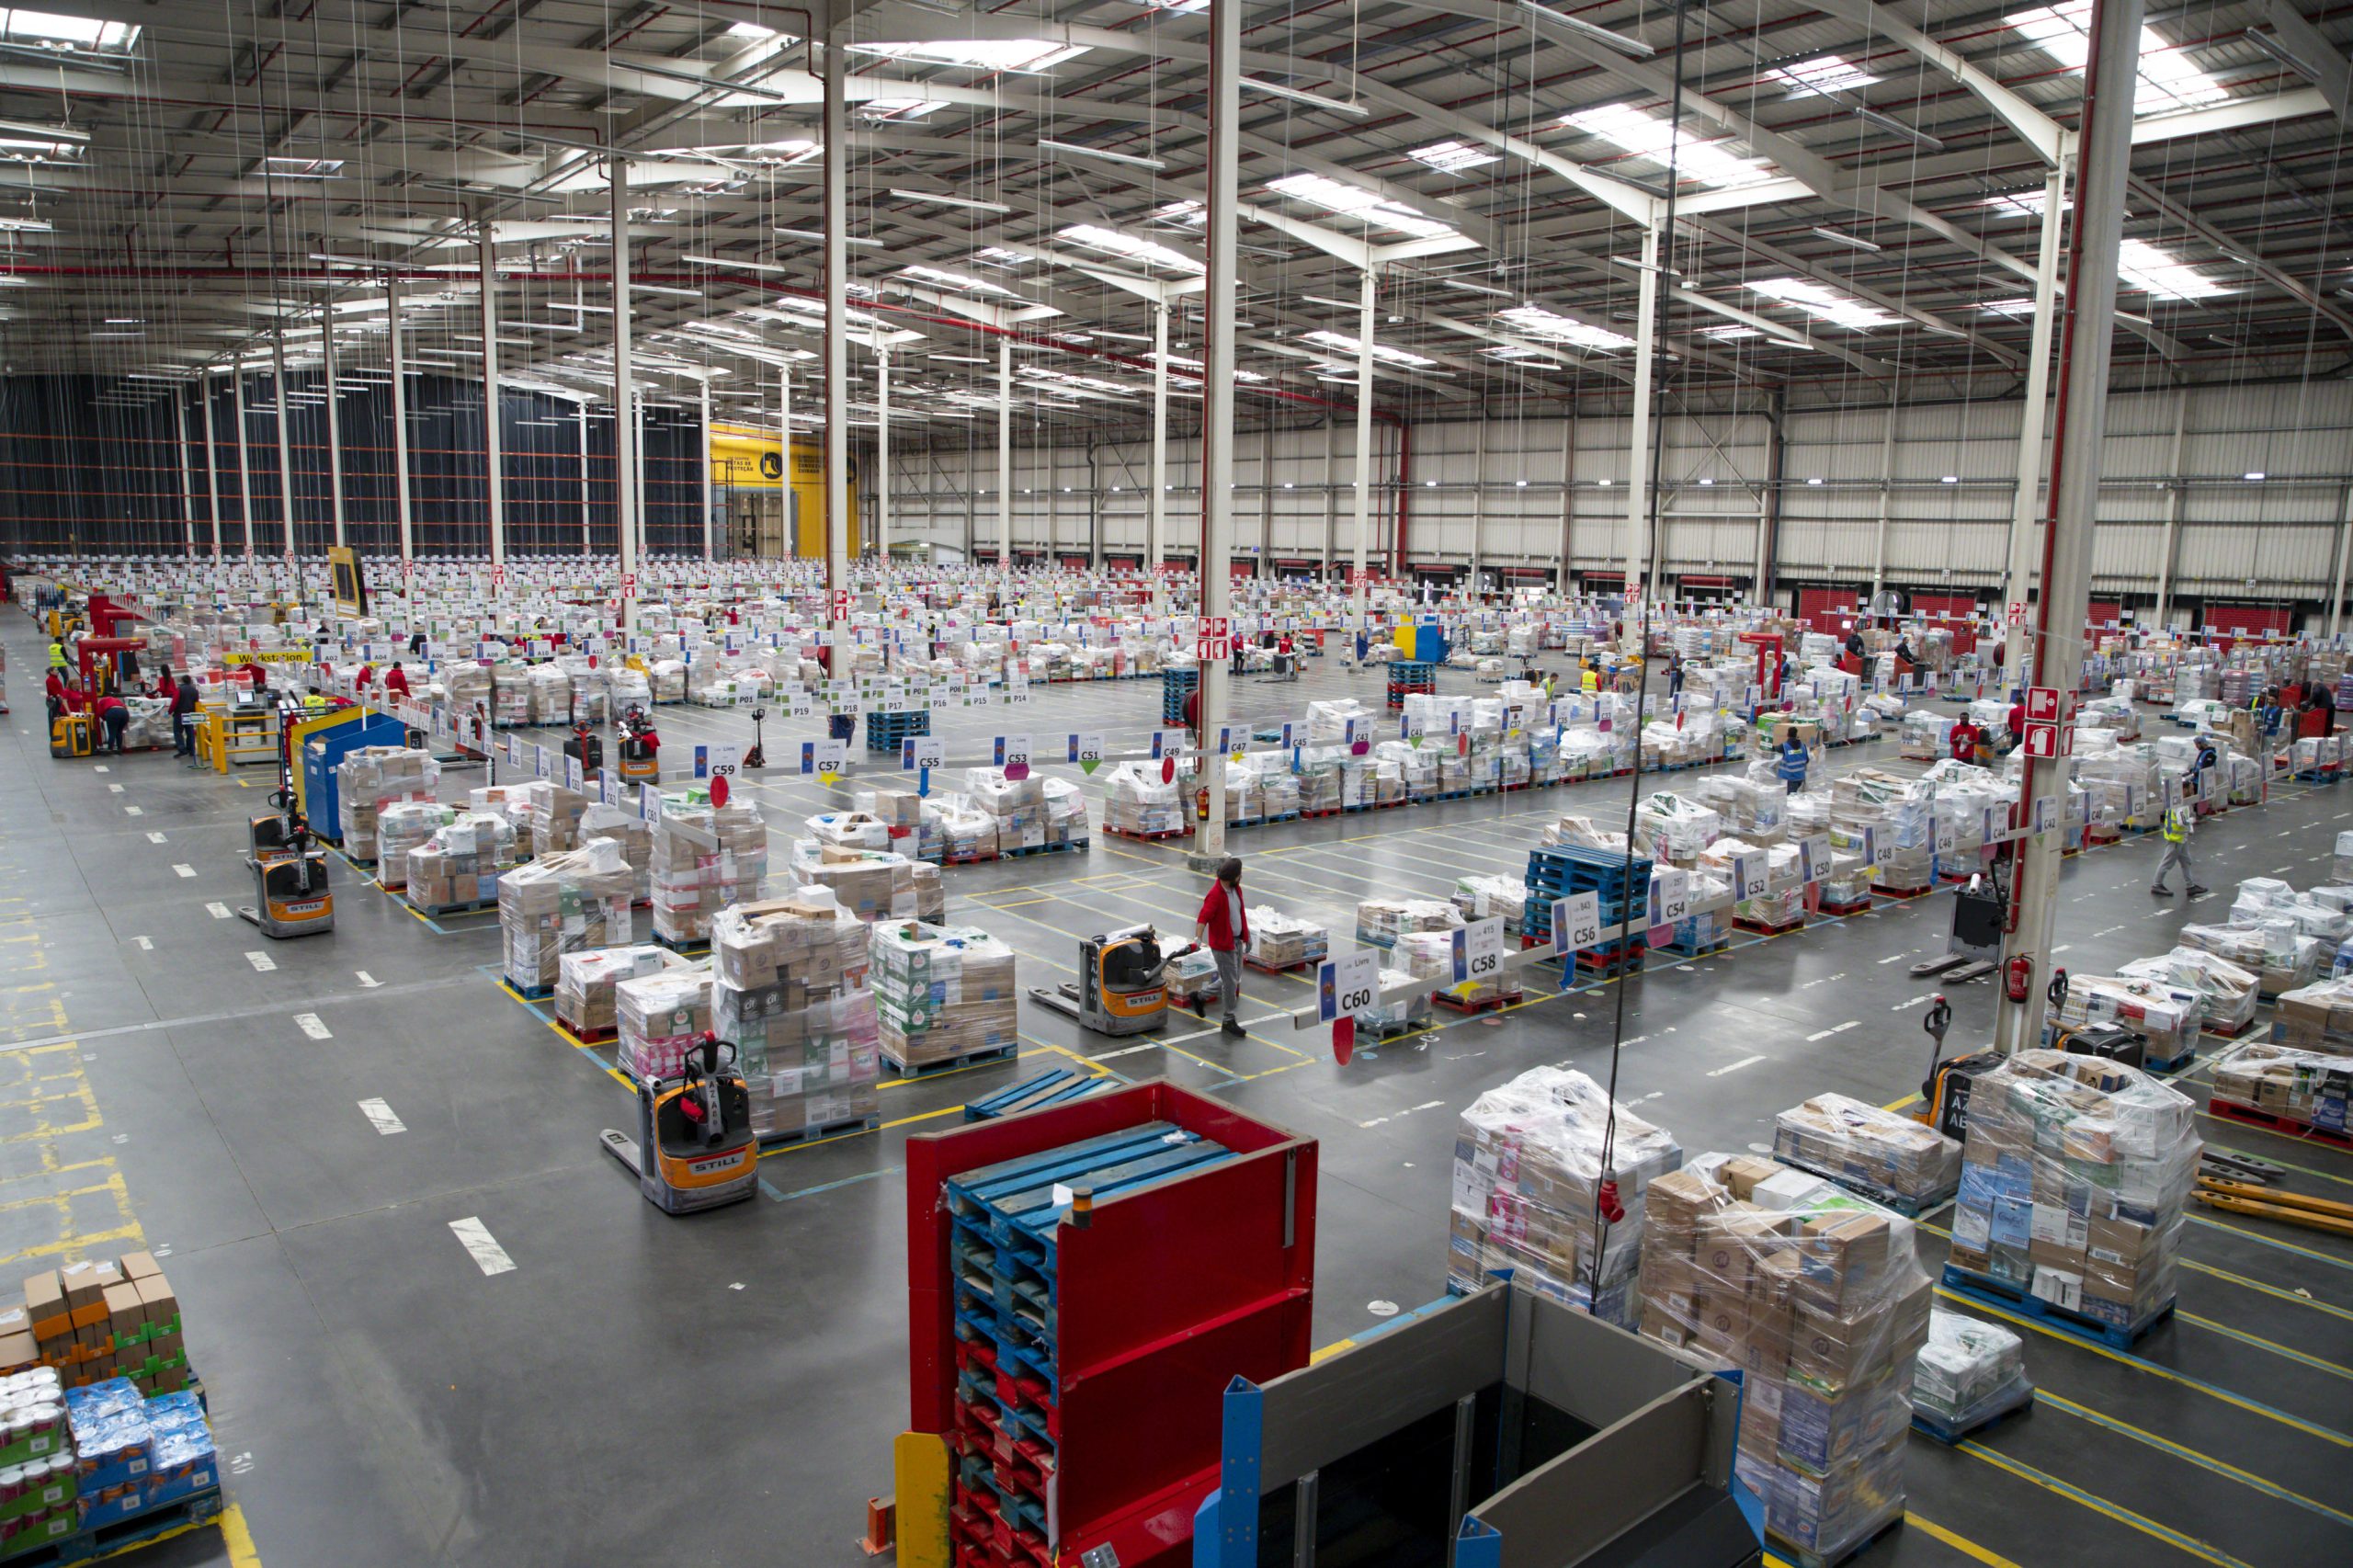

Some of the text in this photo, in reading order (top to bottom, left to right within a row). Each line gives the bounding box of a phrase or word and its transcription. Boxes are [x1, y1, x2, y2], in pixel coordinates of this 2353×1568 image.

[973, 697, 987, 705] P15
[794, 708, 809, 716] P19
[843, 705, 858, 713] P18
[1557, 716, 1568, 724] C35
[1460, 724, 1472, 733] C39
[1292, 738, 1307, 746] C45
[1356, 733, 1369, 742] C43
[1164, 747, 1180, 756] C49
[1231, 743, 1246, 752] C47
[1008, 754, 1027, 763] C53
[1081, 751, 1098, 760] C51
[818, 761, 840, 771] C57
[919, 757, 939, 767] C55
[712, 765, 734, 775] C59
[572, 778, 580, 791] C63
[607, 792, 617, 806] C62
[647, 808, 657, 823] C61
[2091, 810, 2102, 821] C40
[2043, 817, 2055, 830] C42
[1993, 827, 2006, 839] C44
[1938, 836, 1952, 849] C46
[1877, 847, 1893, 860] C48
[1814, 862, 1830, 877] C50
[1747, 880, 1765, 895] C52
[290, 903, 321, 912] STILL
[1666, 902, 1686, 918] C54
[1483, 925, 1495, 935] 415
[1574, 926, 1596, 945] C56
[1472, 954, 1496, 973] C58
[745, 999, 756, 1009] cif
[767, 994, 778, 1005] cif
[1130, 994, 1159, 1006] STILL
[1342, 989, 1370, 1011] C60
[1951, 1096, 1970, 1111] AZ
[695, 1155, 740, 1172] STILL
